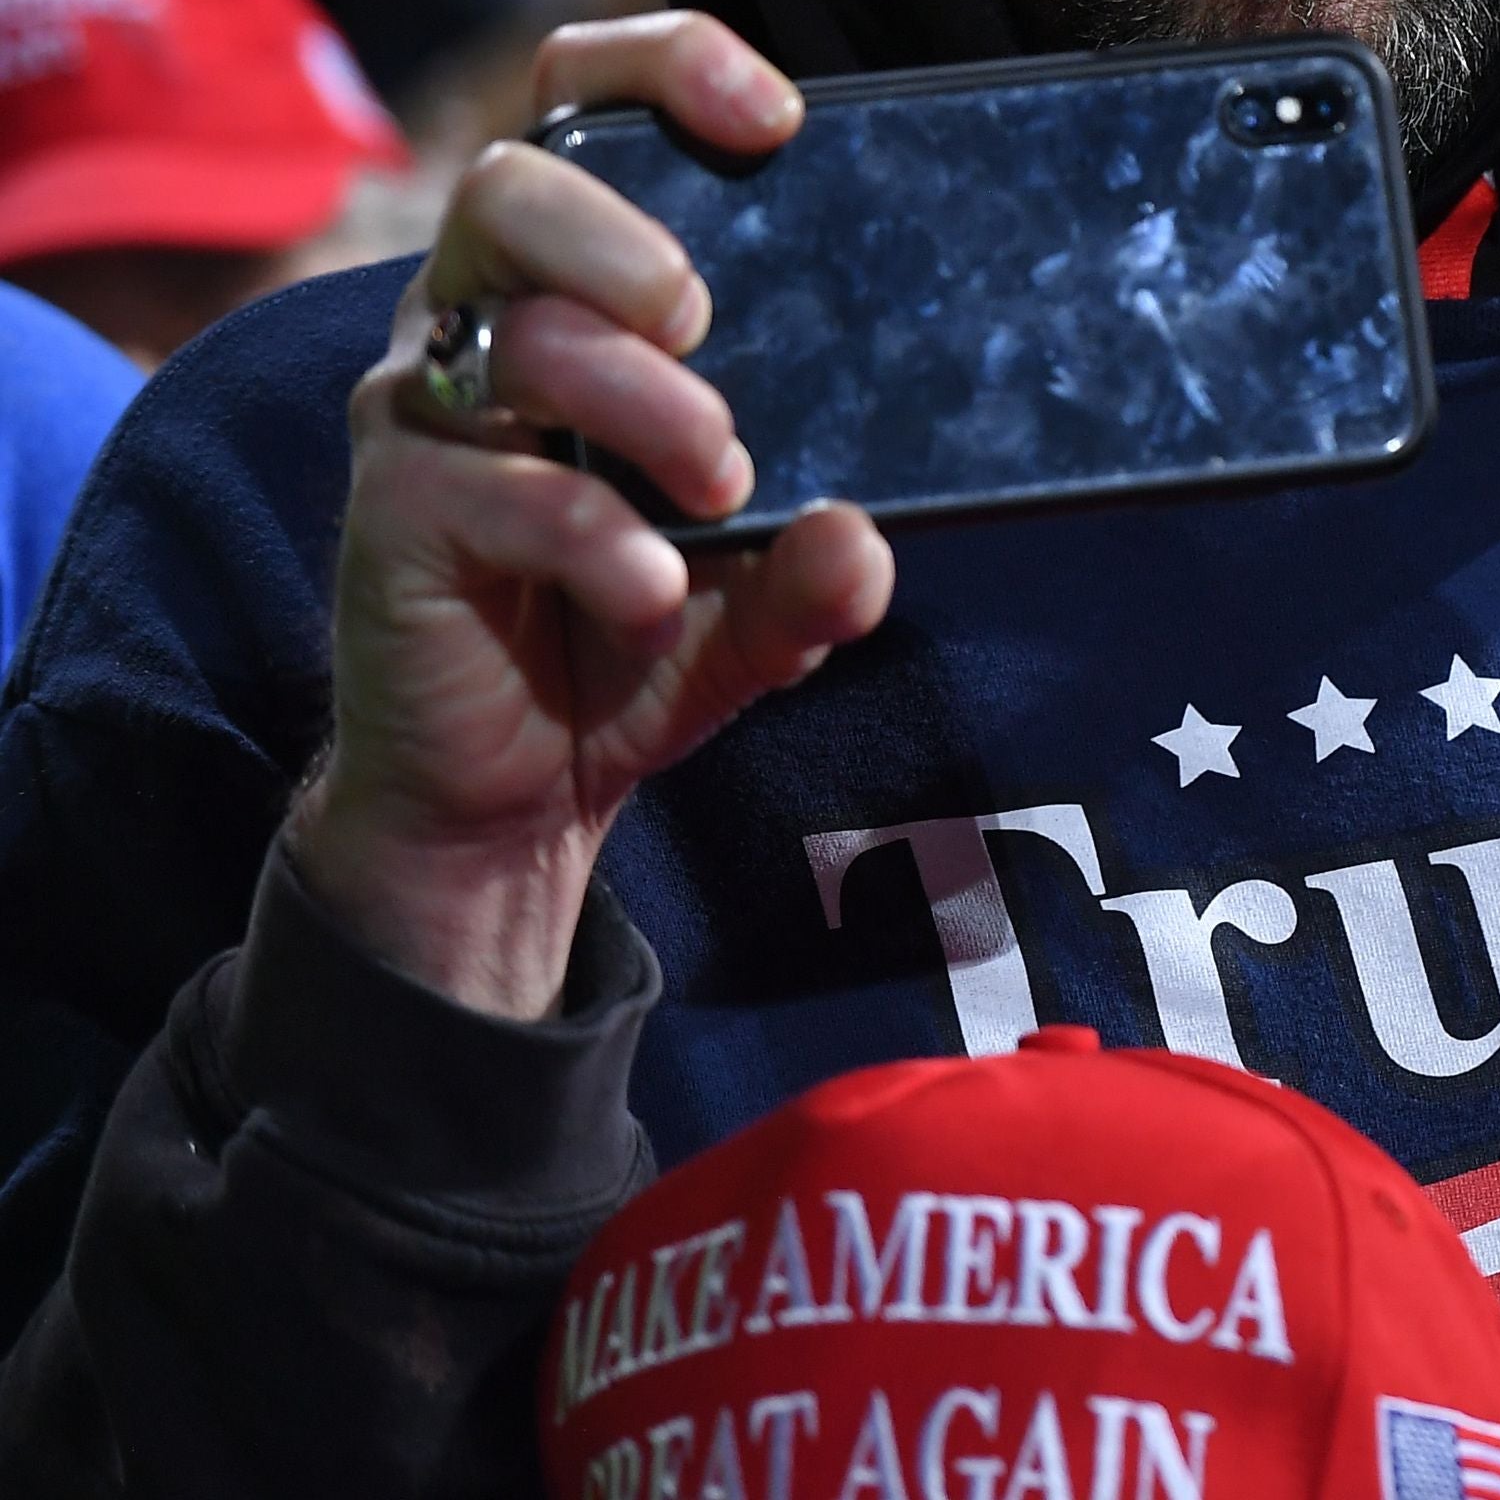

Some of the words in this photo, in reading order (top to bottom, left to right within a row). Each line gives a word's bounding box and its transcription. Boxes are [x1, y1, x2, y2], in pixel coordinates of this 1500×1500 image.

[552, 1217, 747, 1426] MAKE
[743, 1187, 1296, 1366] AMERICA
[837, 1384, 1218, 1500] AGAIN
